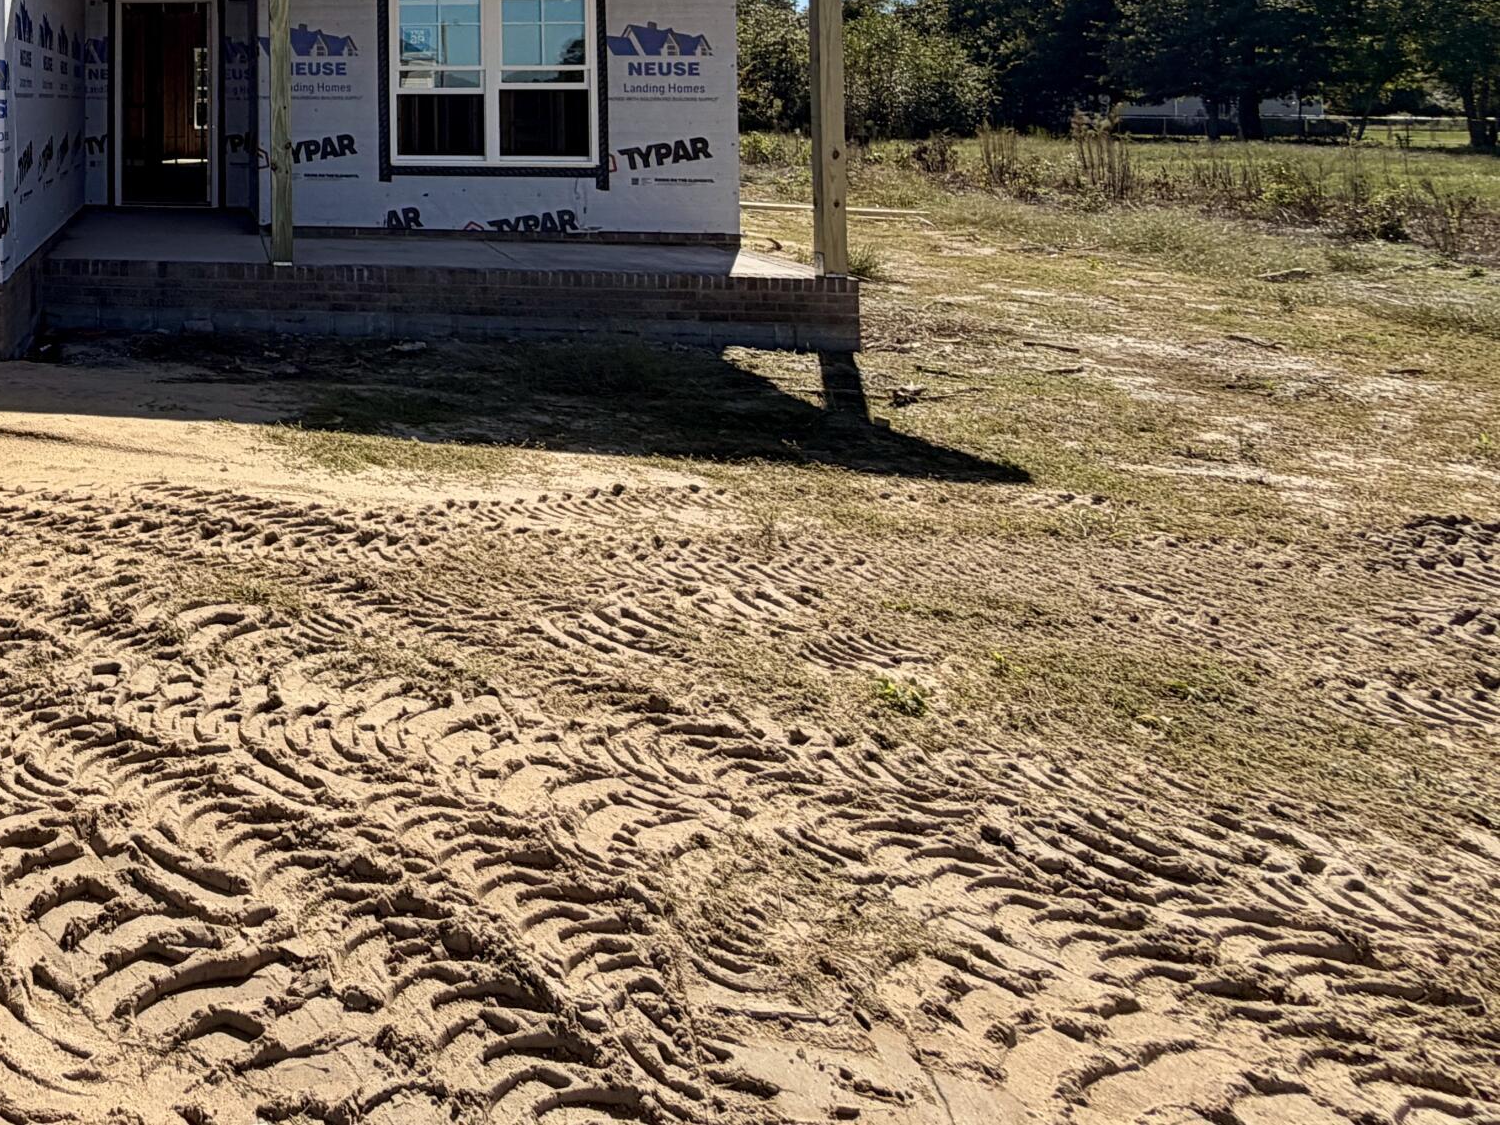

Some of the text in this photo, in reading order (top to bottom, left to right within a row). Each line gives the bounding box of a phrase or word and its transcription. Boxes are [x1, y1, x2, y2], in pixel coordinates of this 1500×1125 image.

[628, 61, 700, 76] NEUSE
[318, 82, 351, 92] Homes
[624, 83, 705, 95] Landing Homes
[617, 137, 713, 170] TYPAR
